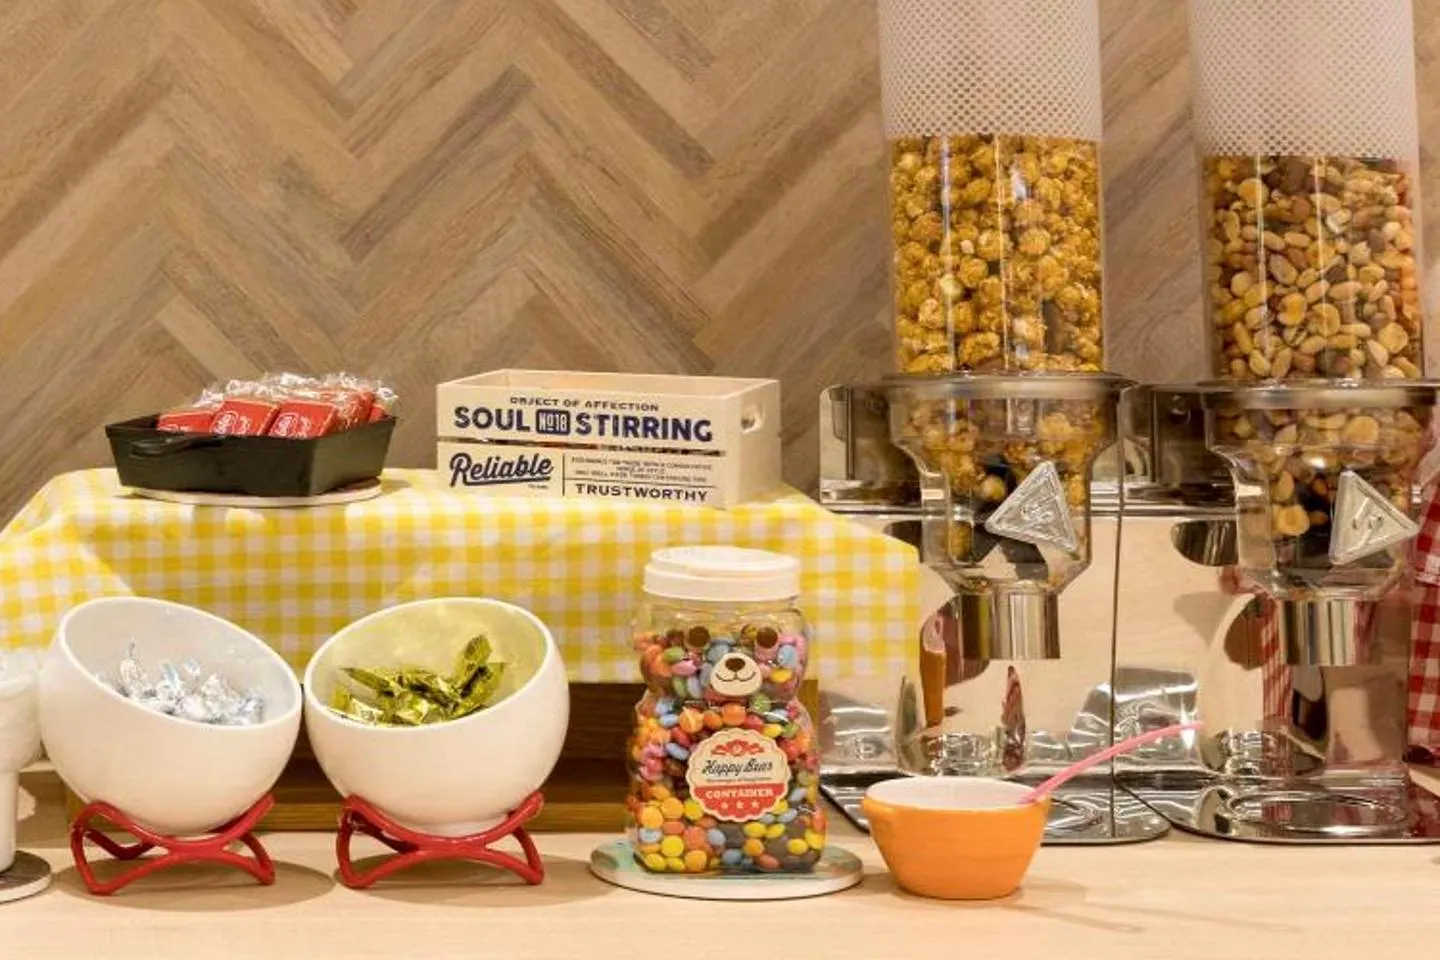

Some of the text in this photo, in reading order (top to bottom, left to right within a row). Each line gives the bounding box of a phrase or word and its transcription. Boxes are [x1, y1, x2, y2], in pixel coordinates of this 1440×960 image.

[510, 396, 659, 412] OBJECT OF AFFECTION
[454, 406, 531, 432] SOUL
[575, 412, 713, 442] STIRRING
[449, 452, 554, 488] Reliable
[575, 483, 708, 502] TRUSTWORTHY
[701, 759, 743, 777] Happy
[705, 787, 774, 799] CONTAINER
